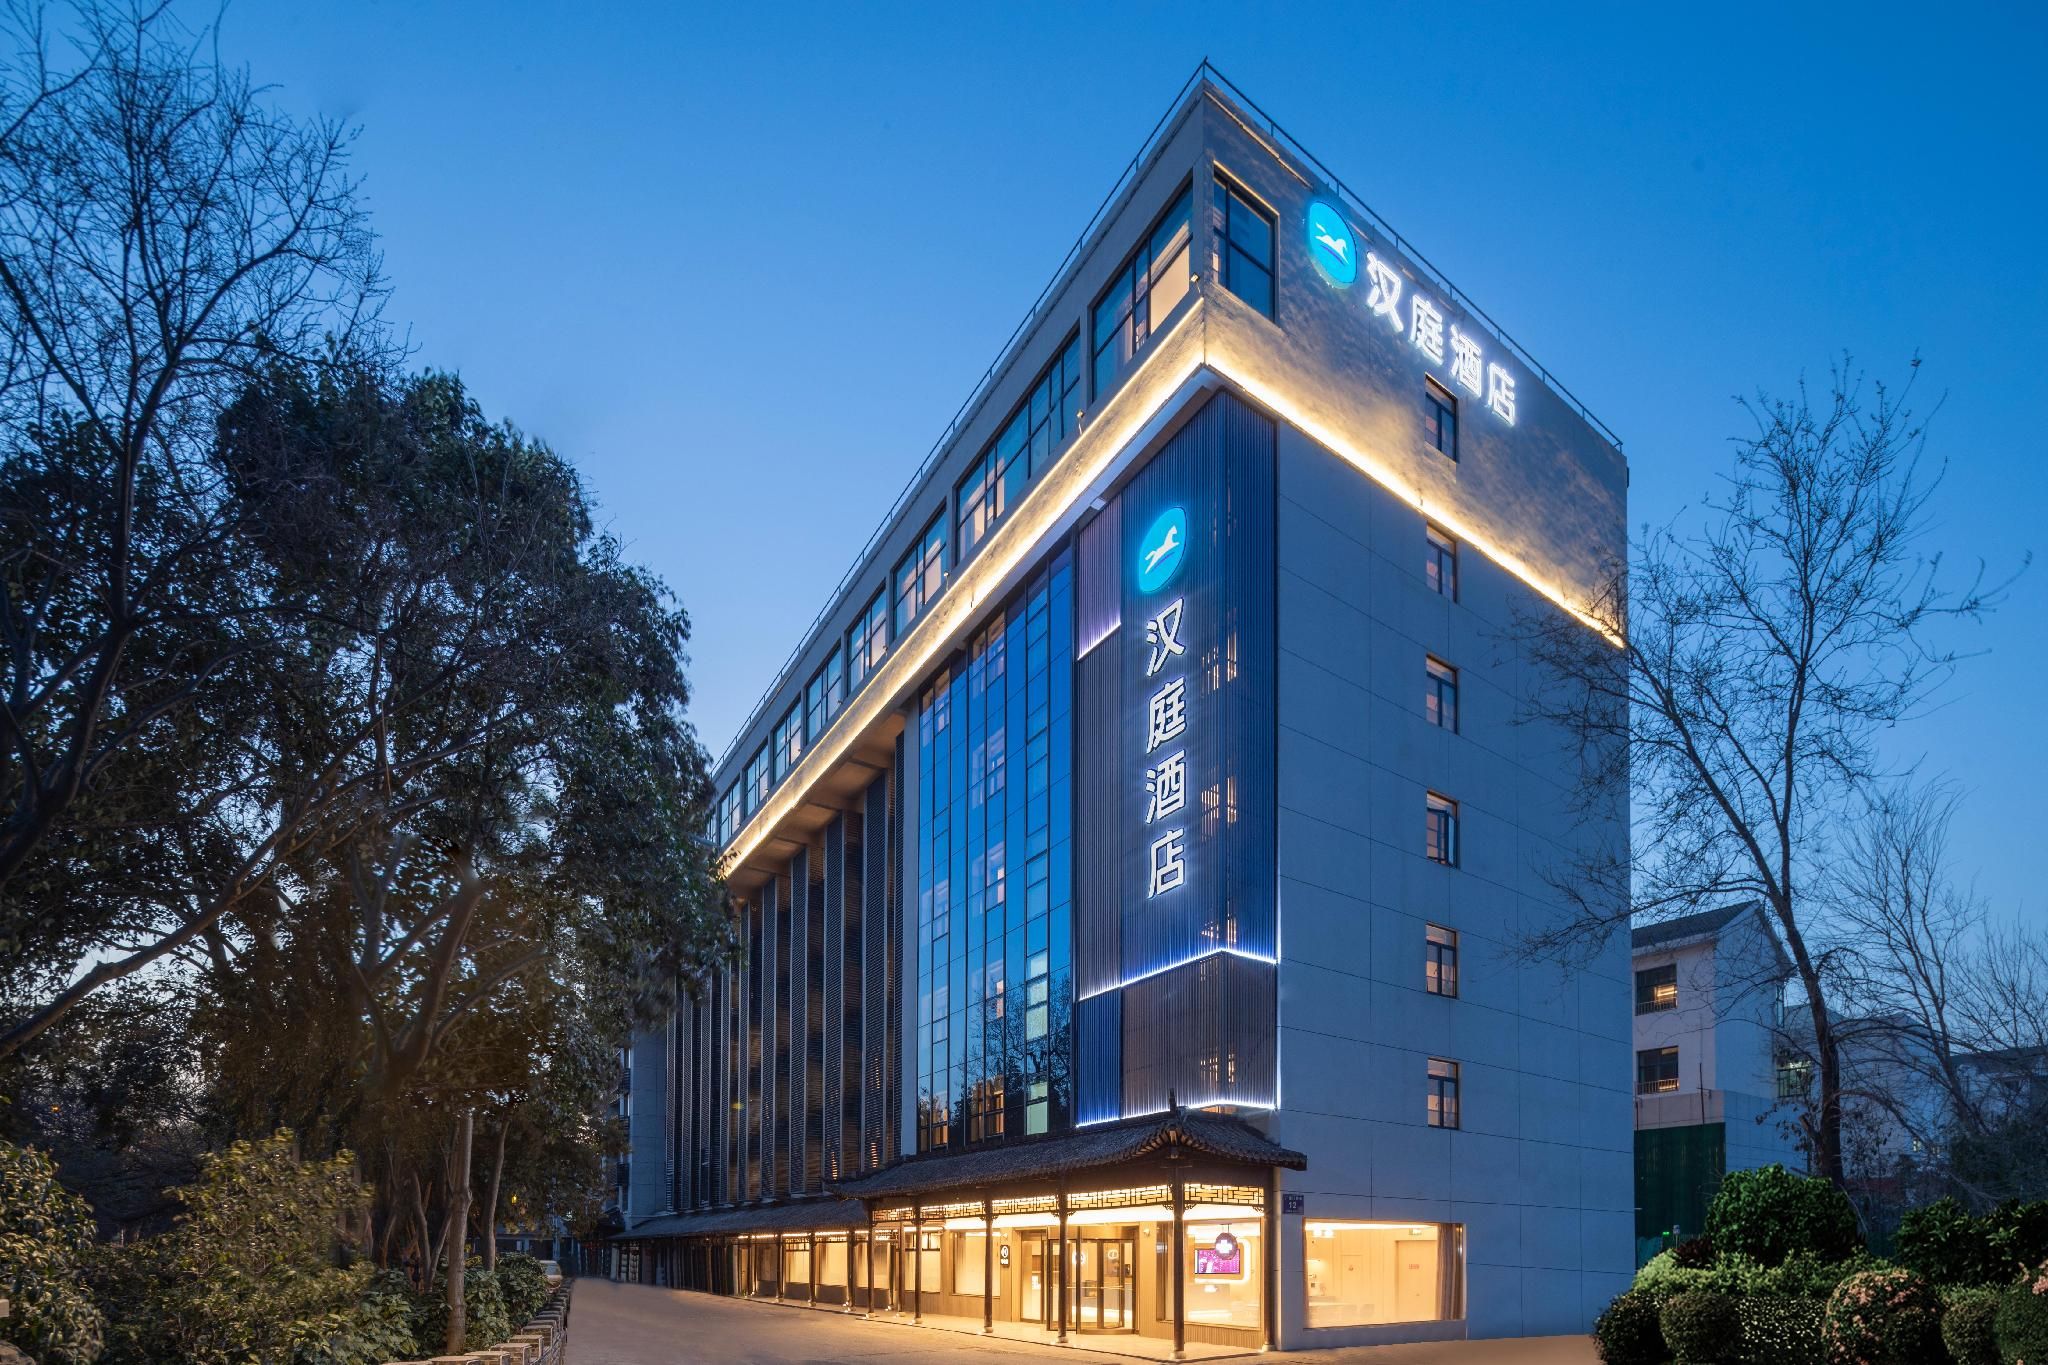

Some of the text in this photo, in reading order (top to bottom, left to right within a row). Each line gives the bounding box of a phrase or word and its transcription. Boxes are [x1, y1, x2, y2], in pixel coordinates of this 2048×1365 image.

[1366, 251, 1516, 426] 汉庭酒店
[1146, 598, 1186, 898] 汉庭酒店
